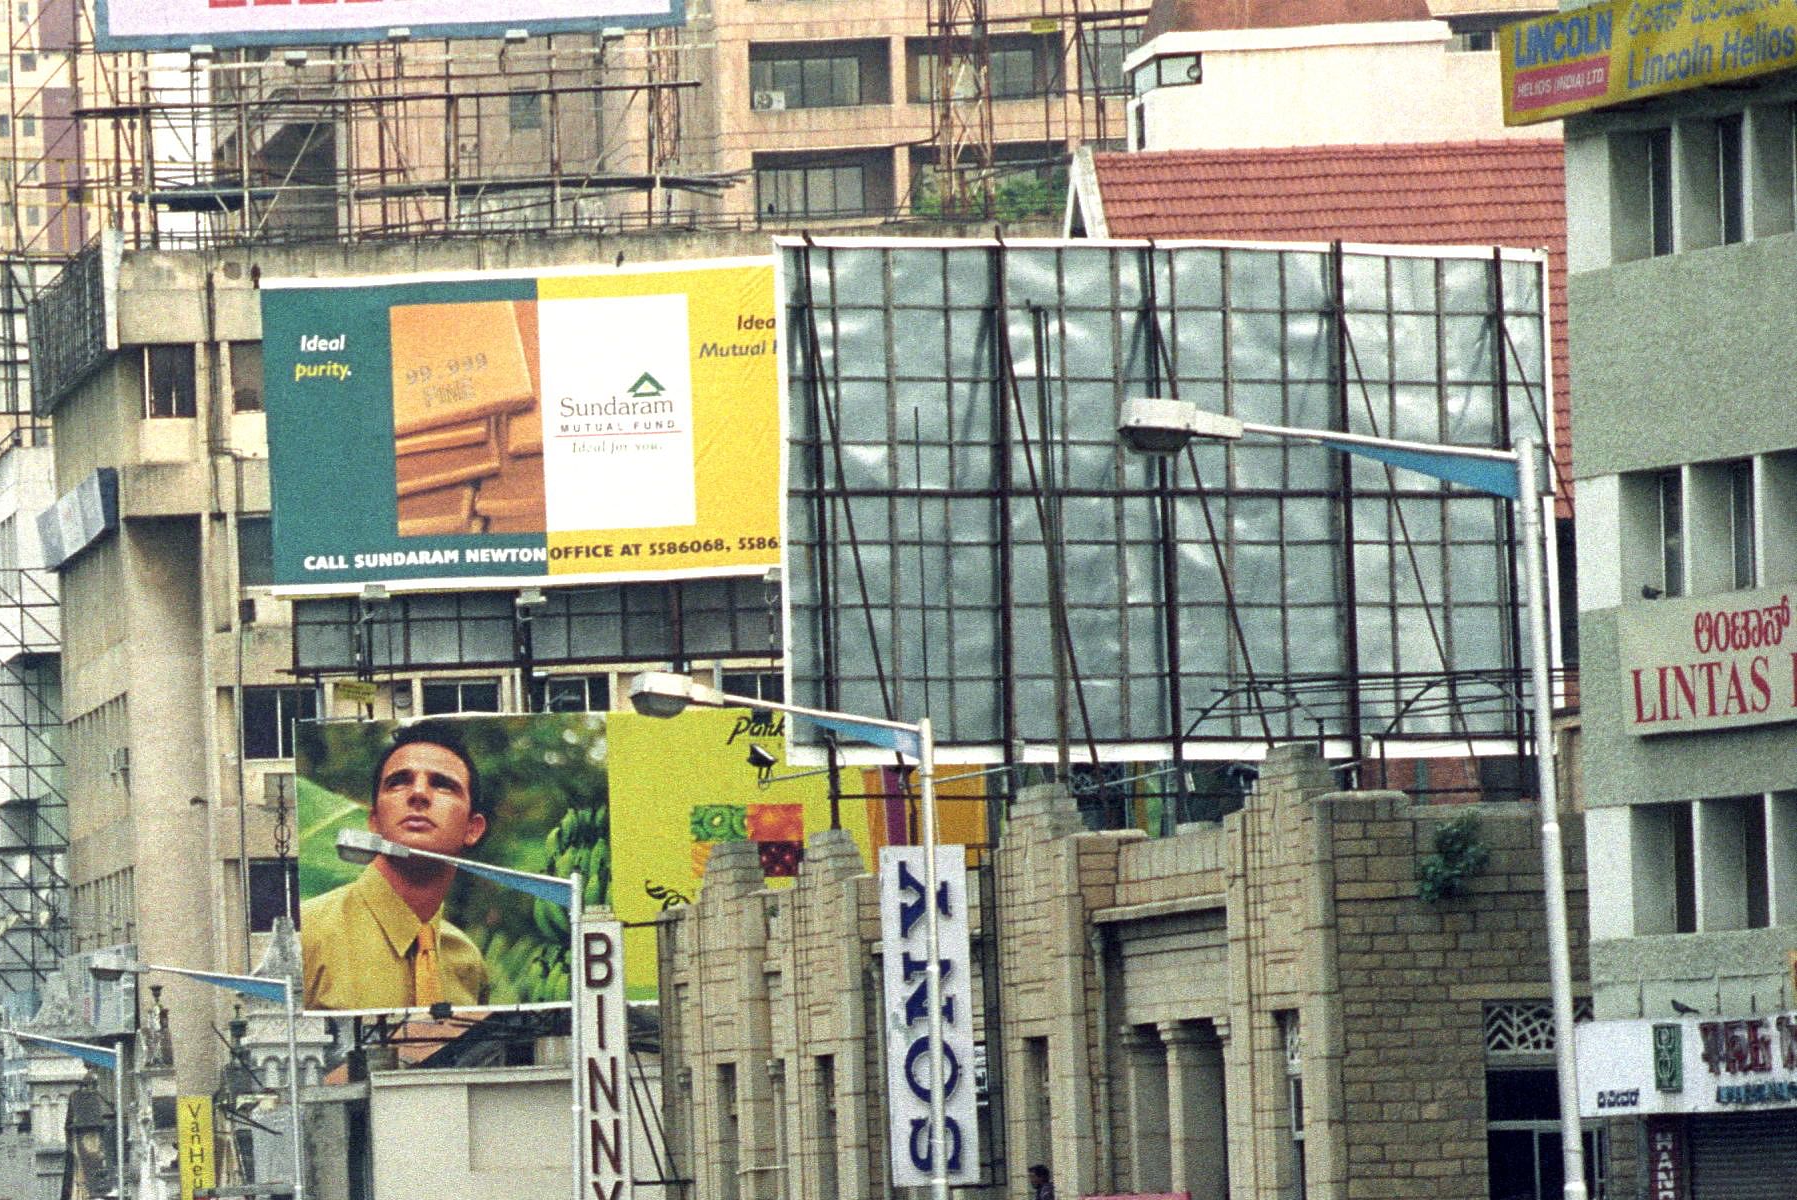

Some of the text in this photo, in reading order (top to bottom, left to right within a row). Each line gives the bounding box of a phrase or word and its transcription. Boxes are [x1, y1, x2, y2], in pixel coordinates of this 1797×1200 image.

[1514, 9, 1612, 69] LINCOLN
[1628, 22, 1796, 90] Lincoln Helios
[737, 314, 776, 331] Idea
[300, 335, 346, 352] Ideal
[699, 340, 767, 359] Mutual
[295, 361, 352, 382] purity.
[406, 352, 488, 385] 99.999
[560, 395, 674, 418] Sundaram
[560, 419, 676, 433] MUTUAL FUND
[304, 555, 348, 571] CALL
[354, 549, 459, 569] SUNDARAM
[466, 546, 546, 564] NEWTON
[549, 543, 613, 561] OFFICE
[620, 543, 642, 557] AT
[738, 536, 781, 551] 5586
[1631, 655, 1772, 724] LINTAS
[897, 860, 962, 1174] SONY
[187, 1103, 205, 1189] Van Heu
